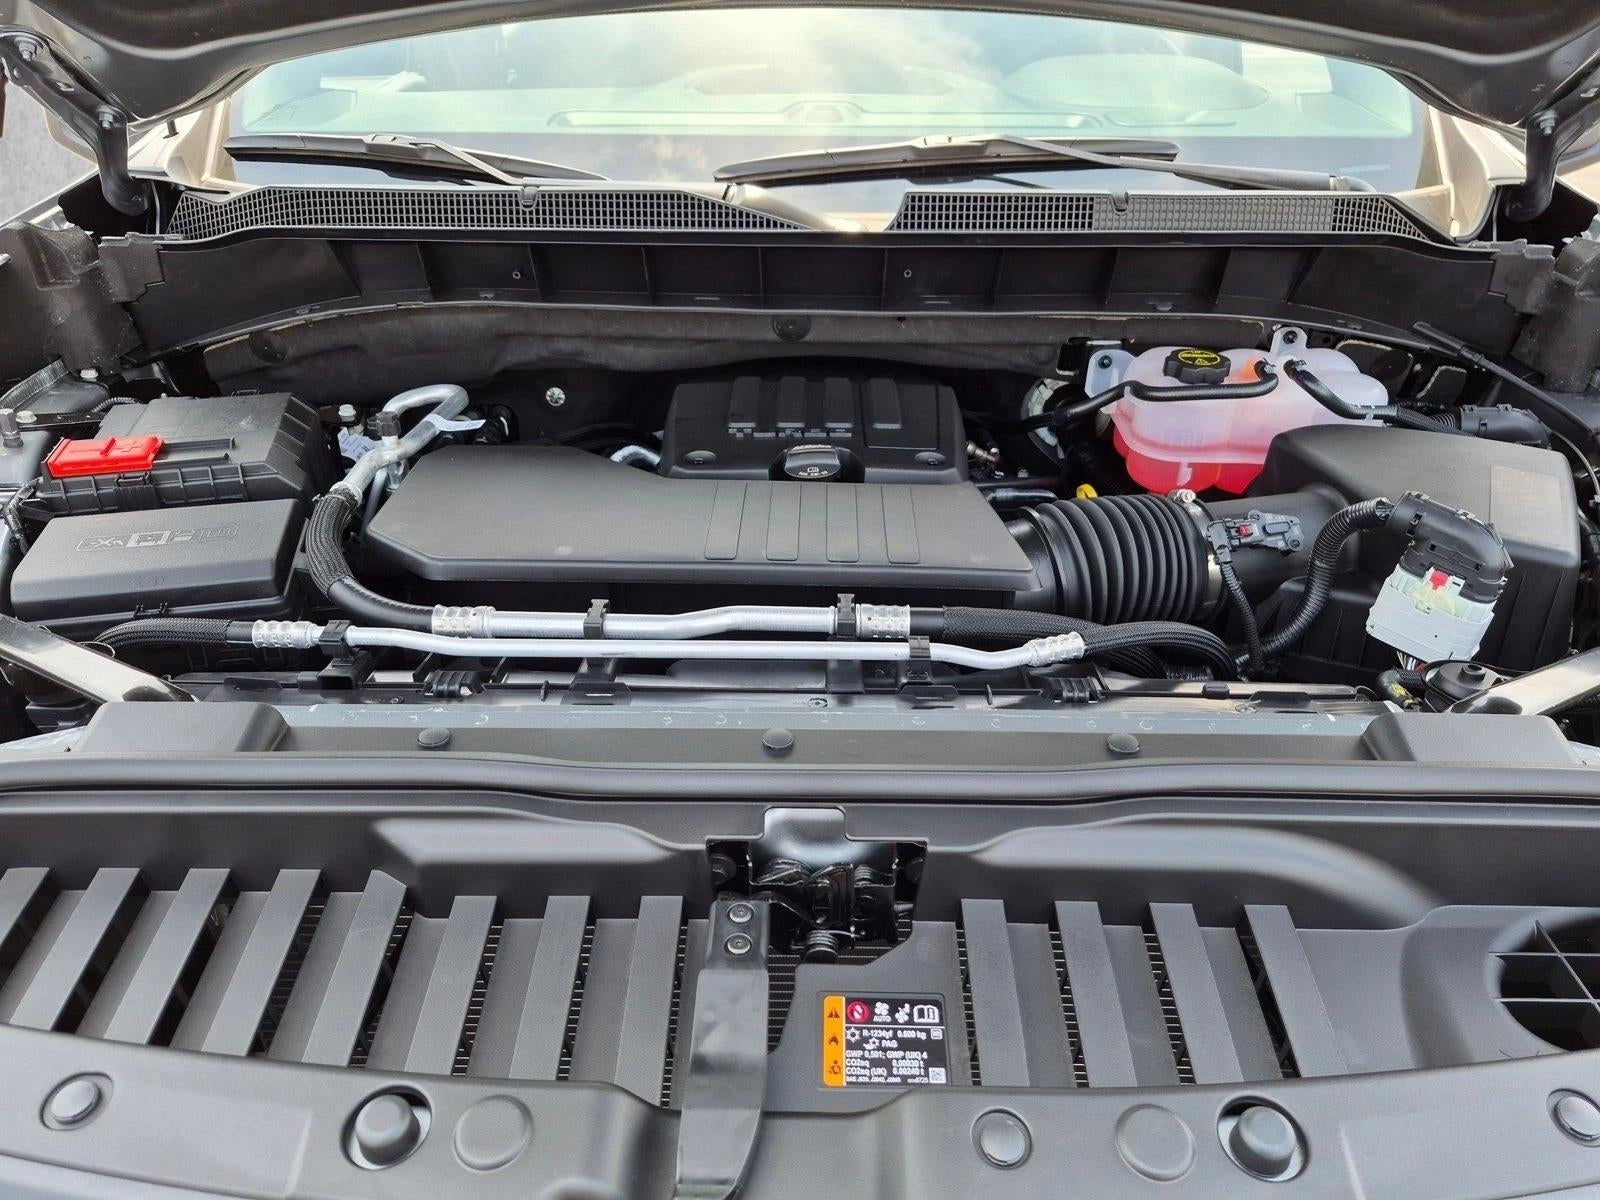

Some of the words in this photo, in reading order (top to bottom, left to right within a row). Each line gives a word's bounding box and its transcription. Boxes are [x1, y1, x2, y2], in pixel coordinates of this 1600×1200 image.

[873, 1015, 892, 1023] AUTO
[862, 1029, 893, 1039] R-1234yf
[917, 1030, 927, 1040] kg
[881, 1040, 898, 1048] PAG
[905, 1051, 921, 1060] (UK)
[845, 1058, 870, 1067] CO2eq
[845, 1067, 870, 1076] CO2eq
[870, 1067, 887, 1076] (UK)
